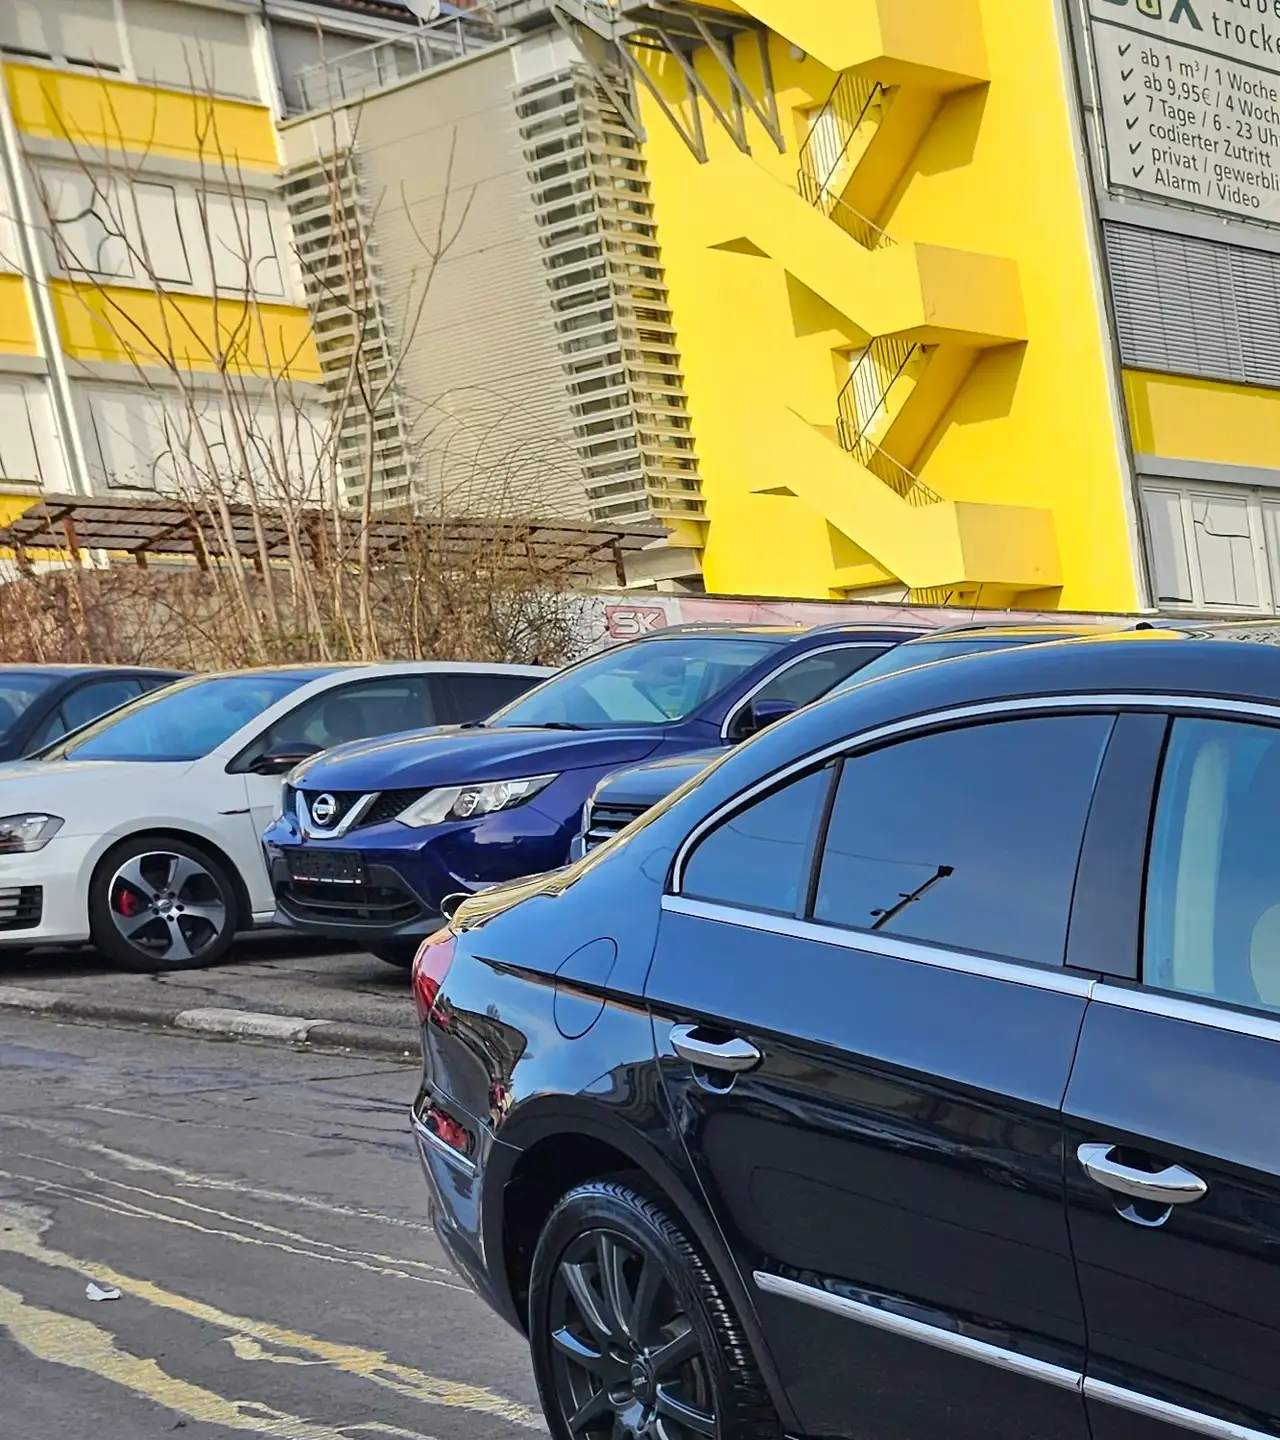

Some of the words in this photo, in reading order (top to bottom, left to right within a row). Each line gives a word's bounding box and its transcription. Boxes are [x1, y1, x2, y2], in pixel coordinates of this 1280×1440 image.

[1141, 48, 1159, 68] ab
[1165, 55, 1172, 72] 1
[1204, 65, 1209, 81] /
[1215, 68, 1222, 85] 1
[1227, 71, 1277, 102] Woche
[1144, 72, 1162, 92] ab
[1168, 78, 1211, 106] 9,95€
[1216, 91, 1220, 108] /
[1226, 95, 1234, 112] 4
[1146, 95, 1154, 112] 7
[1159, 99, 1196, 127] Tage
[1202, 111, 1207, 127] /
[1213, 114, 1222, 131] 6
[1236, 120, 1253, 140] 23
[1149, 123, 1220, 153] codierter
[1224, 139, 1272, 168] Zutritt
[1152, 146, 1199, 171] privat
[1204, 157, 1208, 173] /
[1154, 168, 1201, 194] Alarm
[1207, 180, 1211, 197] /
[1216, 182, 1260, 209] Video
[611, 611, 661, 634] SK
